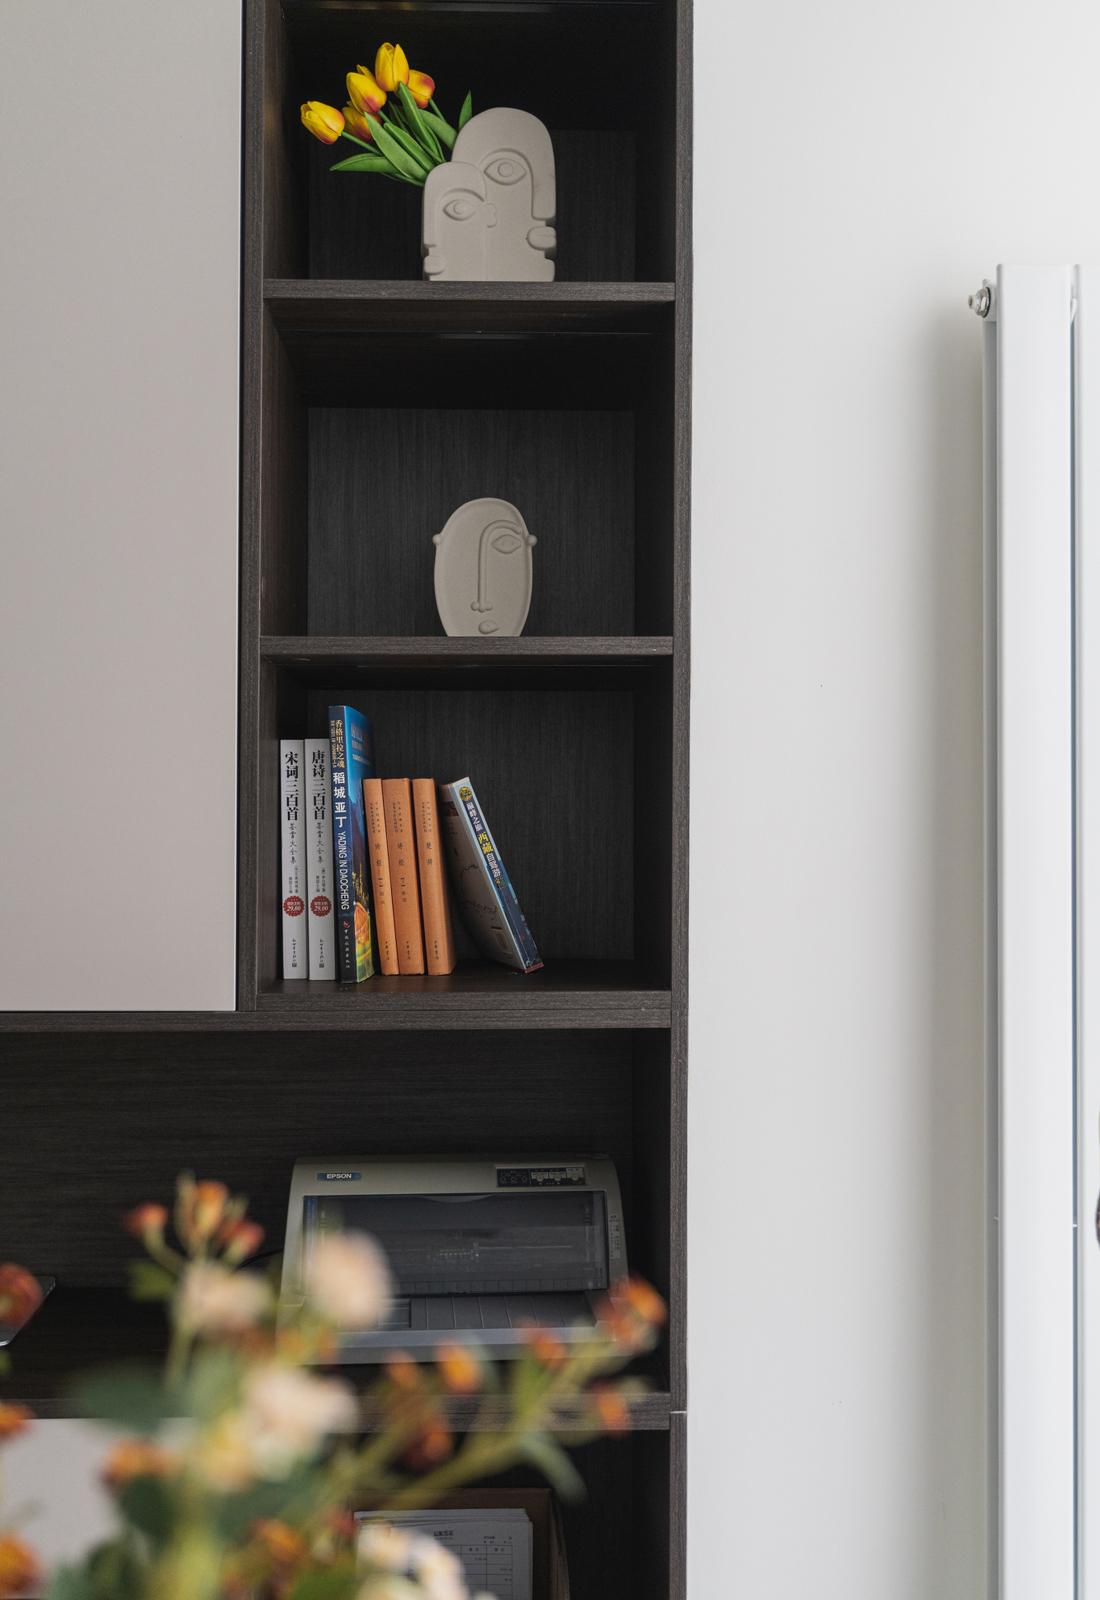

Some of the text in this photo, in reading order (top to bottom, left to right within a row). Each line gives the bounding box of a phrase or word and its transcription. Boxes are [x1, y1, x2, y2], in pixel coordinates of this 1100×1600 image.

[285, 751, 299, 820] 宋词三百首
[312, 750, 326, 820] 唐诗三百首
[332, 772, 347, 828] 稻城亚丁
[337, 831, 347, 859] YADING
[340, 869, 350, 910] DAOCHENG
